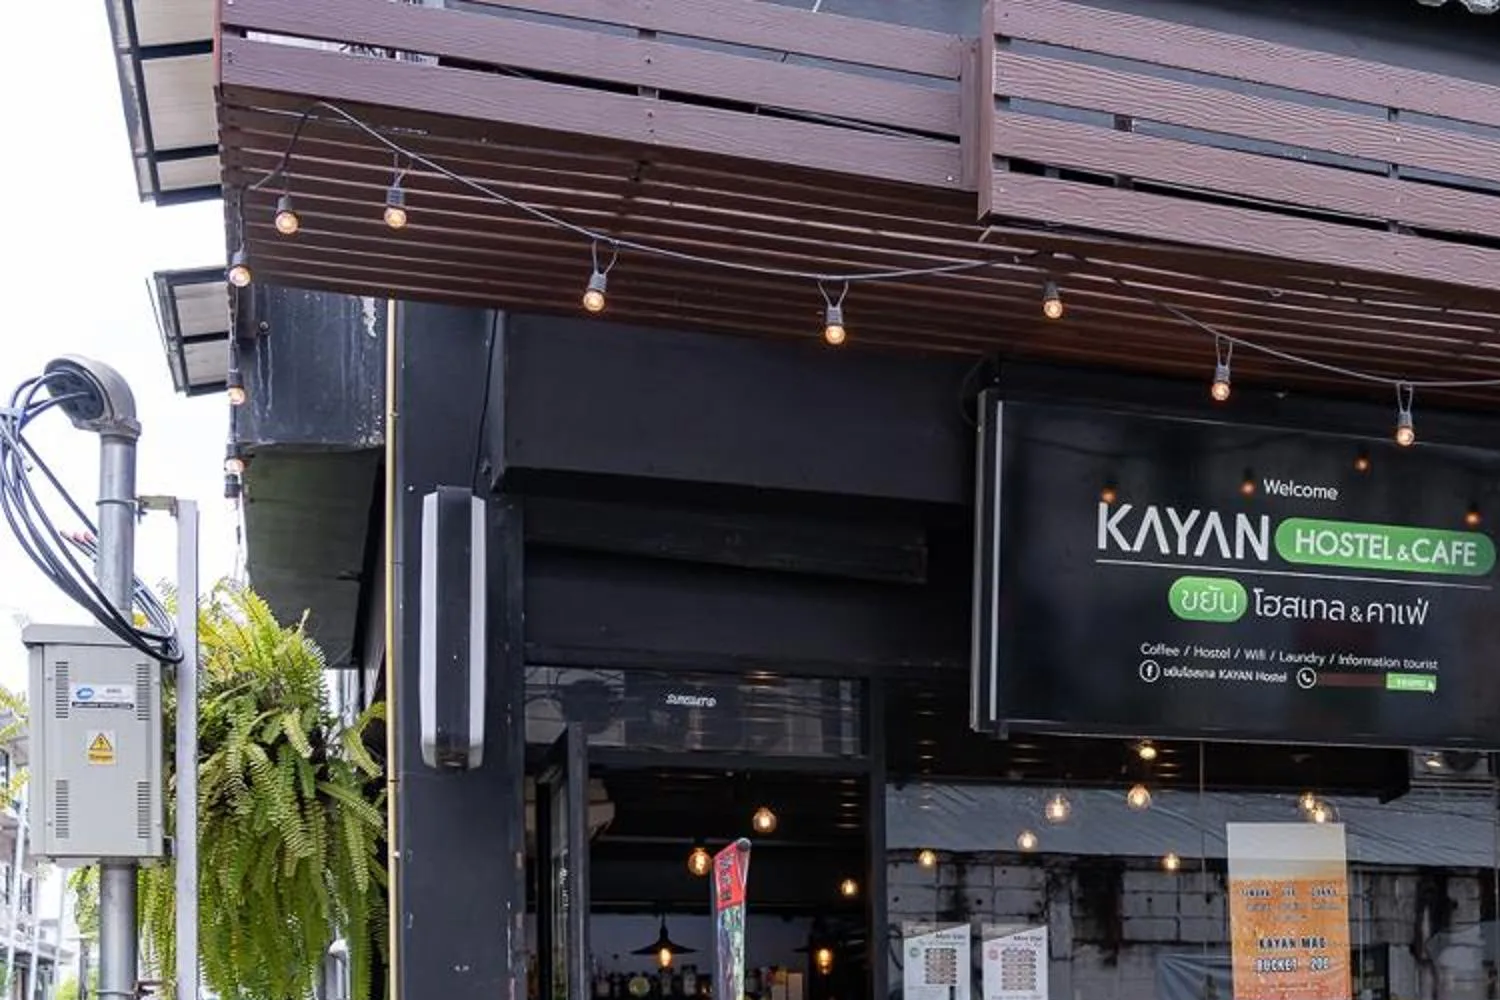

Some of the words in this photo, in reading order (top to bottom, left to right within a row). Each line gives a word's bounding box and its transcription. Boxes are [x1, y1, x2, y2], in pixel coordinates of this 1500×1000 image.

[1263, 479, 1338, 500] Welcome
[1098, 501, 1269, 561] KAYAN
[1181, 585, 1238, 614] ขยัน
[1140, 642, 1180, 657] Coffee
[1194, 645, 1231, 659] Hostel
[1279, 651, 1326, 666] Laundry
[1338, 654, 1400, 668] Information
[1403, 658, 1439, 670] tourist
[1218, 668, 1253, 682] KAYAN
[1255, 671, 1288, 683] Hostel
[1259, 936, 1297, 949] KAYAN
[1255, 957, 1297, 972] BUCKET
